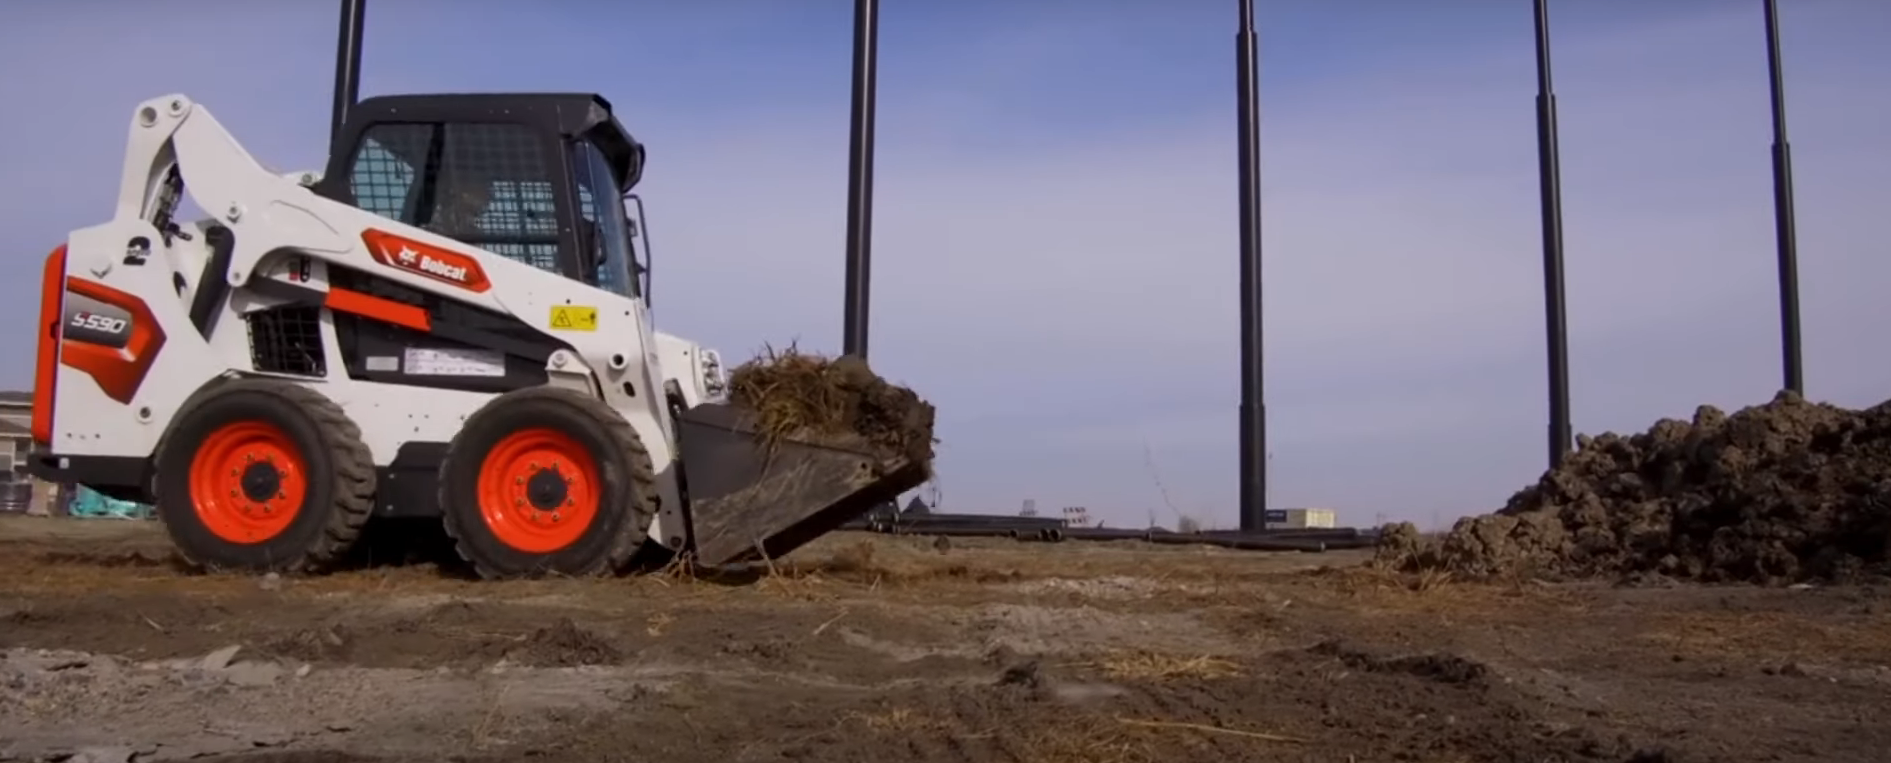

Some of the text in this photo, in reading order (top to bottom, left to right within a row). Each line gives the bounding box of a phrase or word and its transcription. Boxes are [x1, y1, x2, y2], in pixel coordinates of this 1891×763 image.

[123, 236, 149, 264] 2
[420, 253, 466, 281] Bobcat
[71, 312, 126, 333] S590
